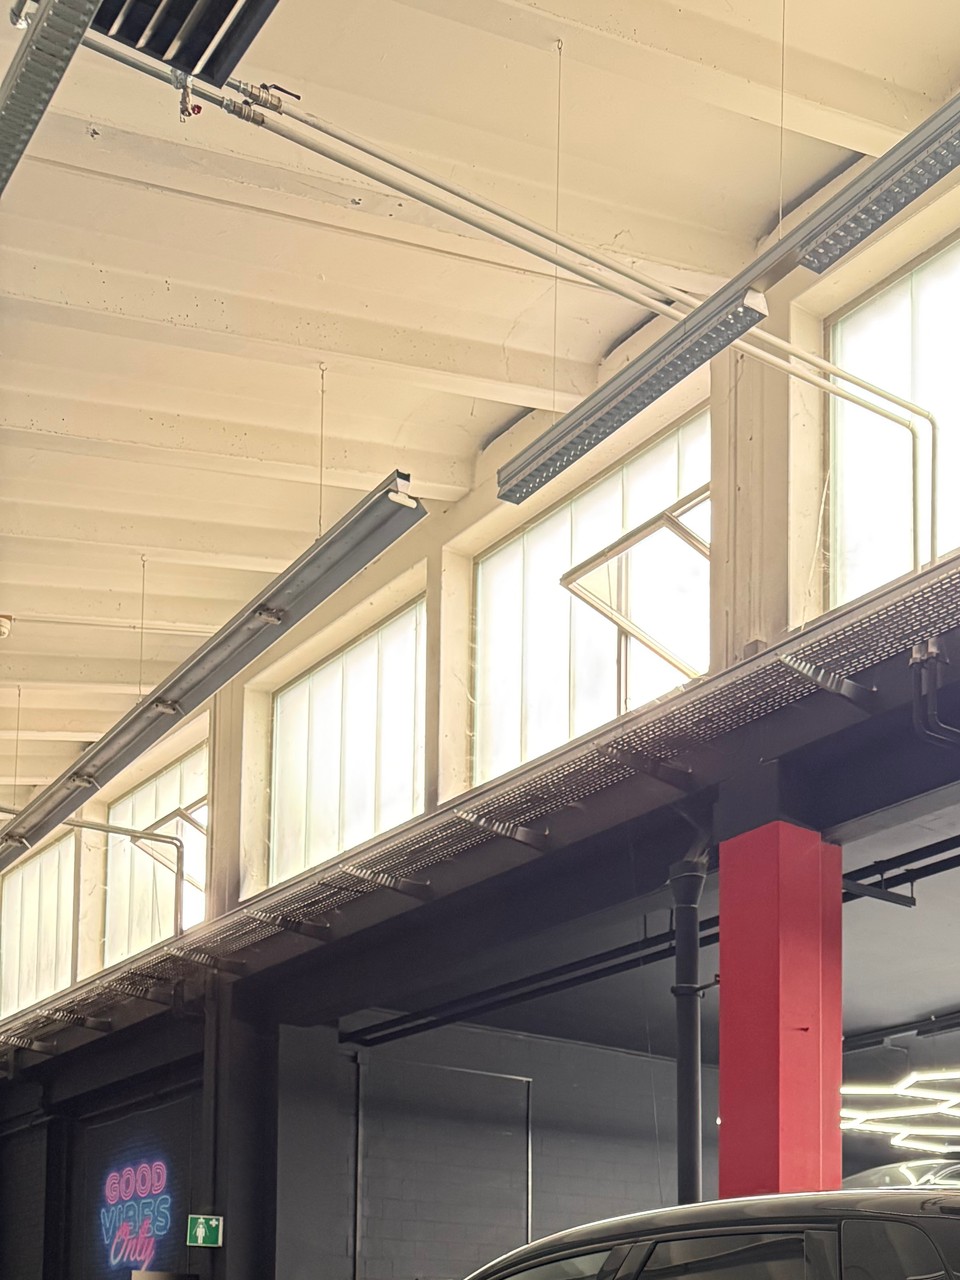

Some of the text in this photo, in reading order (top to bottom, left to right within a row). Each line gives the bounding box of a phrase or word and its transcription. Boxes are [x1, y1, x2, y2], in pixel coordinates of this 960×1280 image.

[106, 1161, 167, 1204] GOOD
[101, 1195, 171, 1244] VIBES
[110, 1218, 155, 1271] Only
